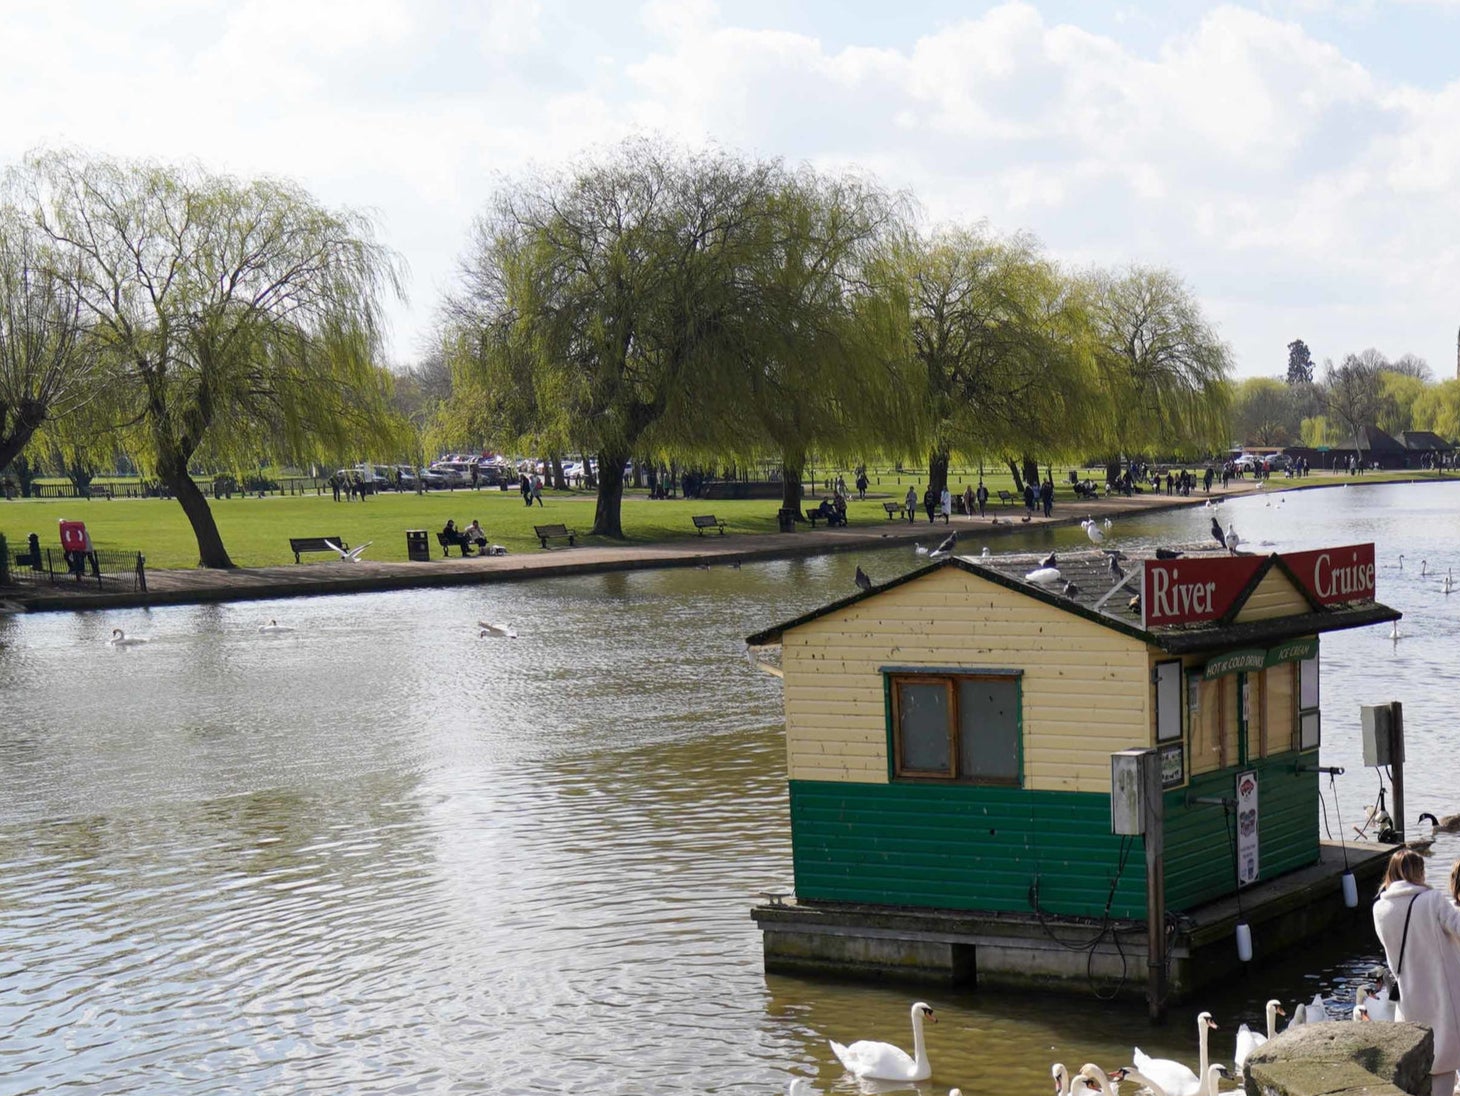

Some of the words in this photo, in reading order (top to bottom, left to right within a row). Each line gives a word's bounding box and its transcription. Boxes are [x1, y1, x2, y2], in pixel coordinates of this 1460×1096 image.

[1151, 567, 1216, 618] River
[1314, 551, 1375, 599] Cruise
[1279, 648, 1291, 659] ICE
[1290, 645, 1310, 658] CREAM
[1206, 662, 1221, 678] HOT
[1228, 656, 1246, 670] COLD
[1245, 655, 1265, 668] DRINKS
